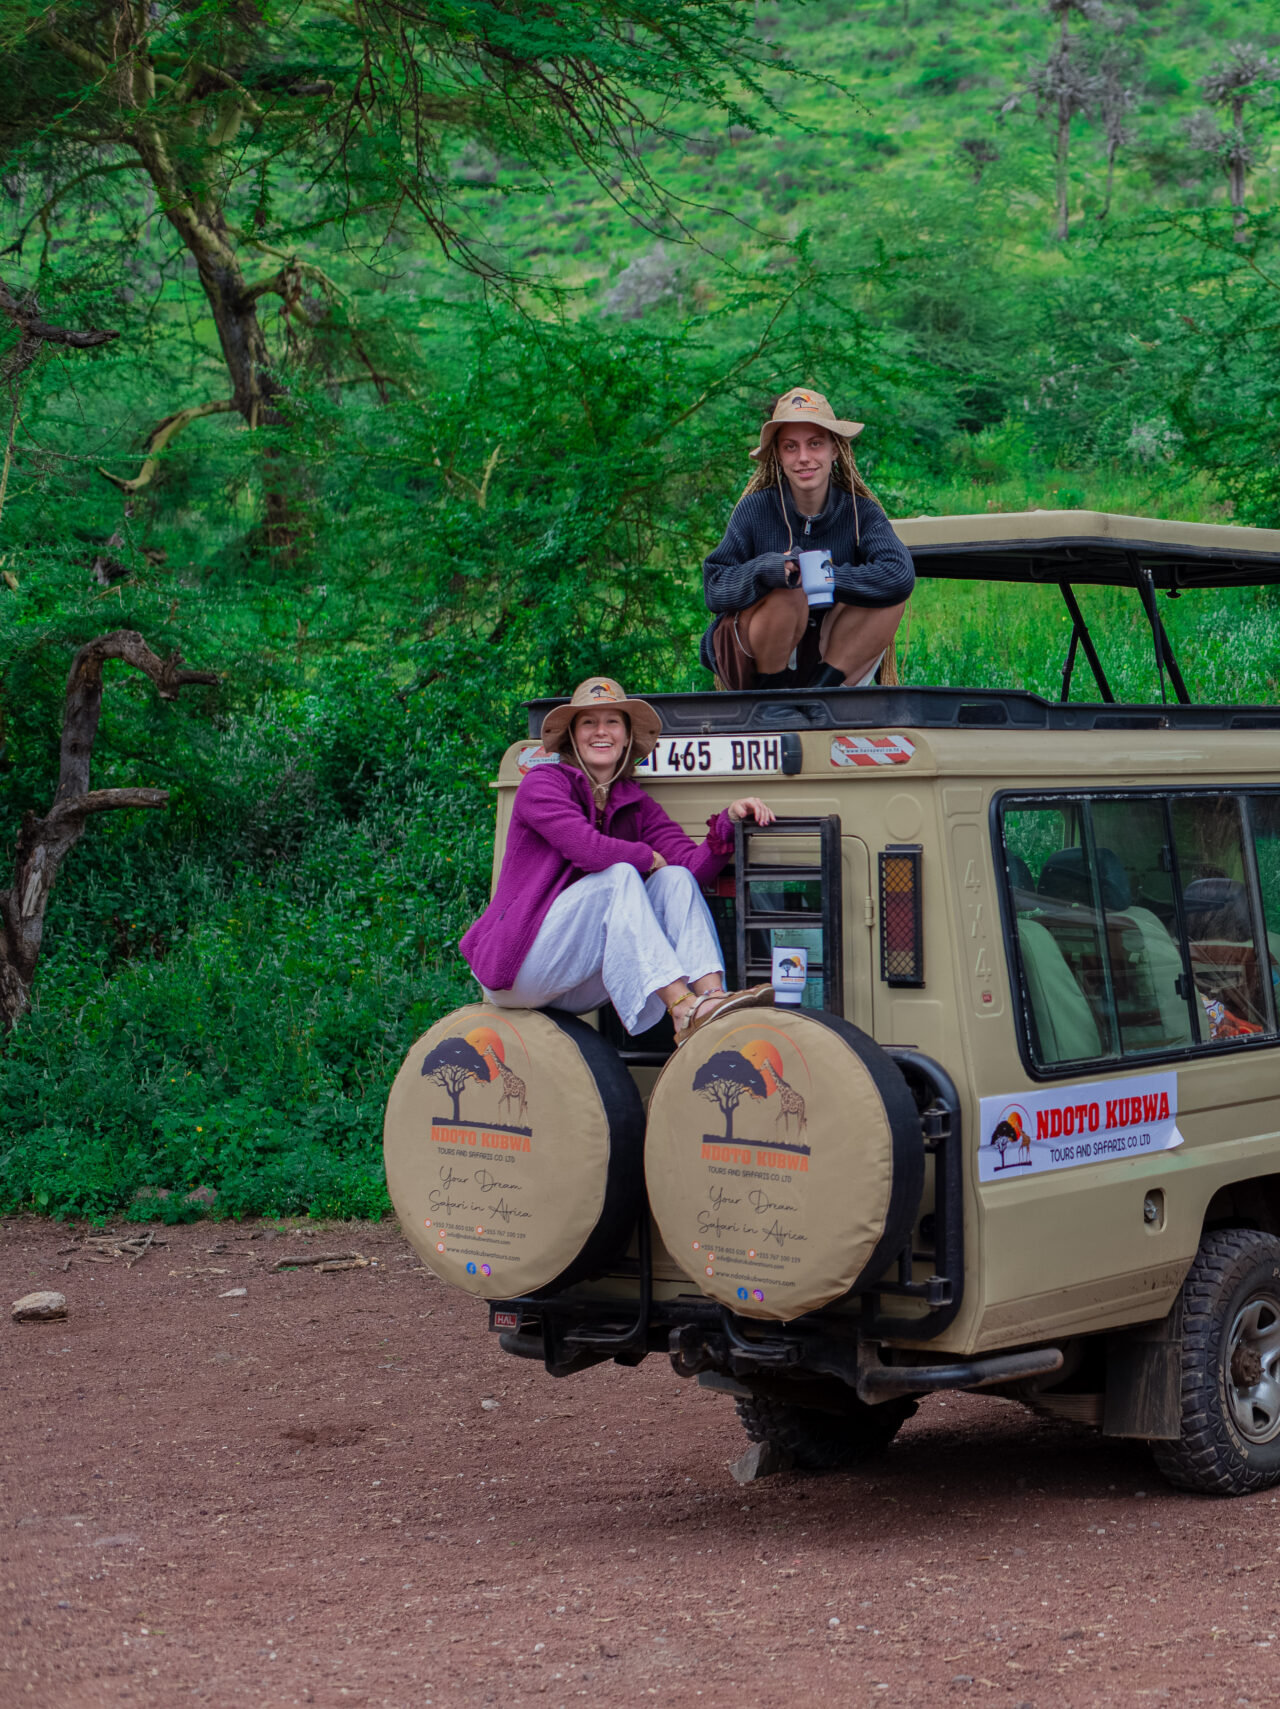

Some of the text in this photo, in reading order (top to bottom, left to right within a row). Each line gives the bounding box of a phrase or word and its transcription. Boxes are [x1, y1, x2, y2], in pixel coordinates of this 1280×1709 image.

[668, 741, 711, 771] 465
[1036, 1092, 1170, 1140] NDOTO KUBWA
[431, 1126, 531, 1152] NDOTO KUBWA
[1050, 1147, 1074, 1163] TOURS
[1076, 1144, 1092, 1159] AND
[1140, 1133, 1151, 1146] LTD
[701, 1144, 809, 1172] NDOTO KUBWA
[440, 1166, 522, 1192] Your Dream
[708, 1166, 726, 1175] TOURS
[728, 1169, 740, 1177] AND
[742, 1170, 769, 1180] SAFARIS
[781, 1175, 792, 1183] LTD
[429, 1190, 532, 1223] Safari in Africa
[709, 1186, 797, 1214] Your Dream
[697, 1211, 807, 1247] Safari in Africa
